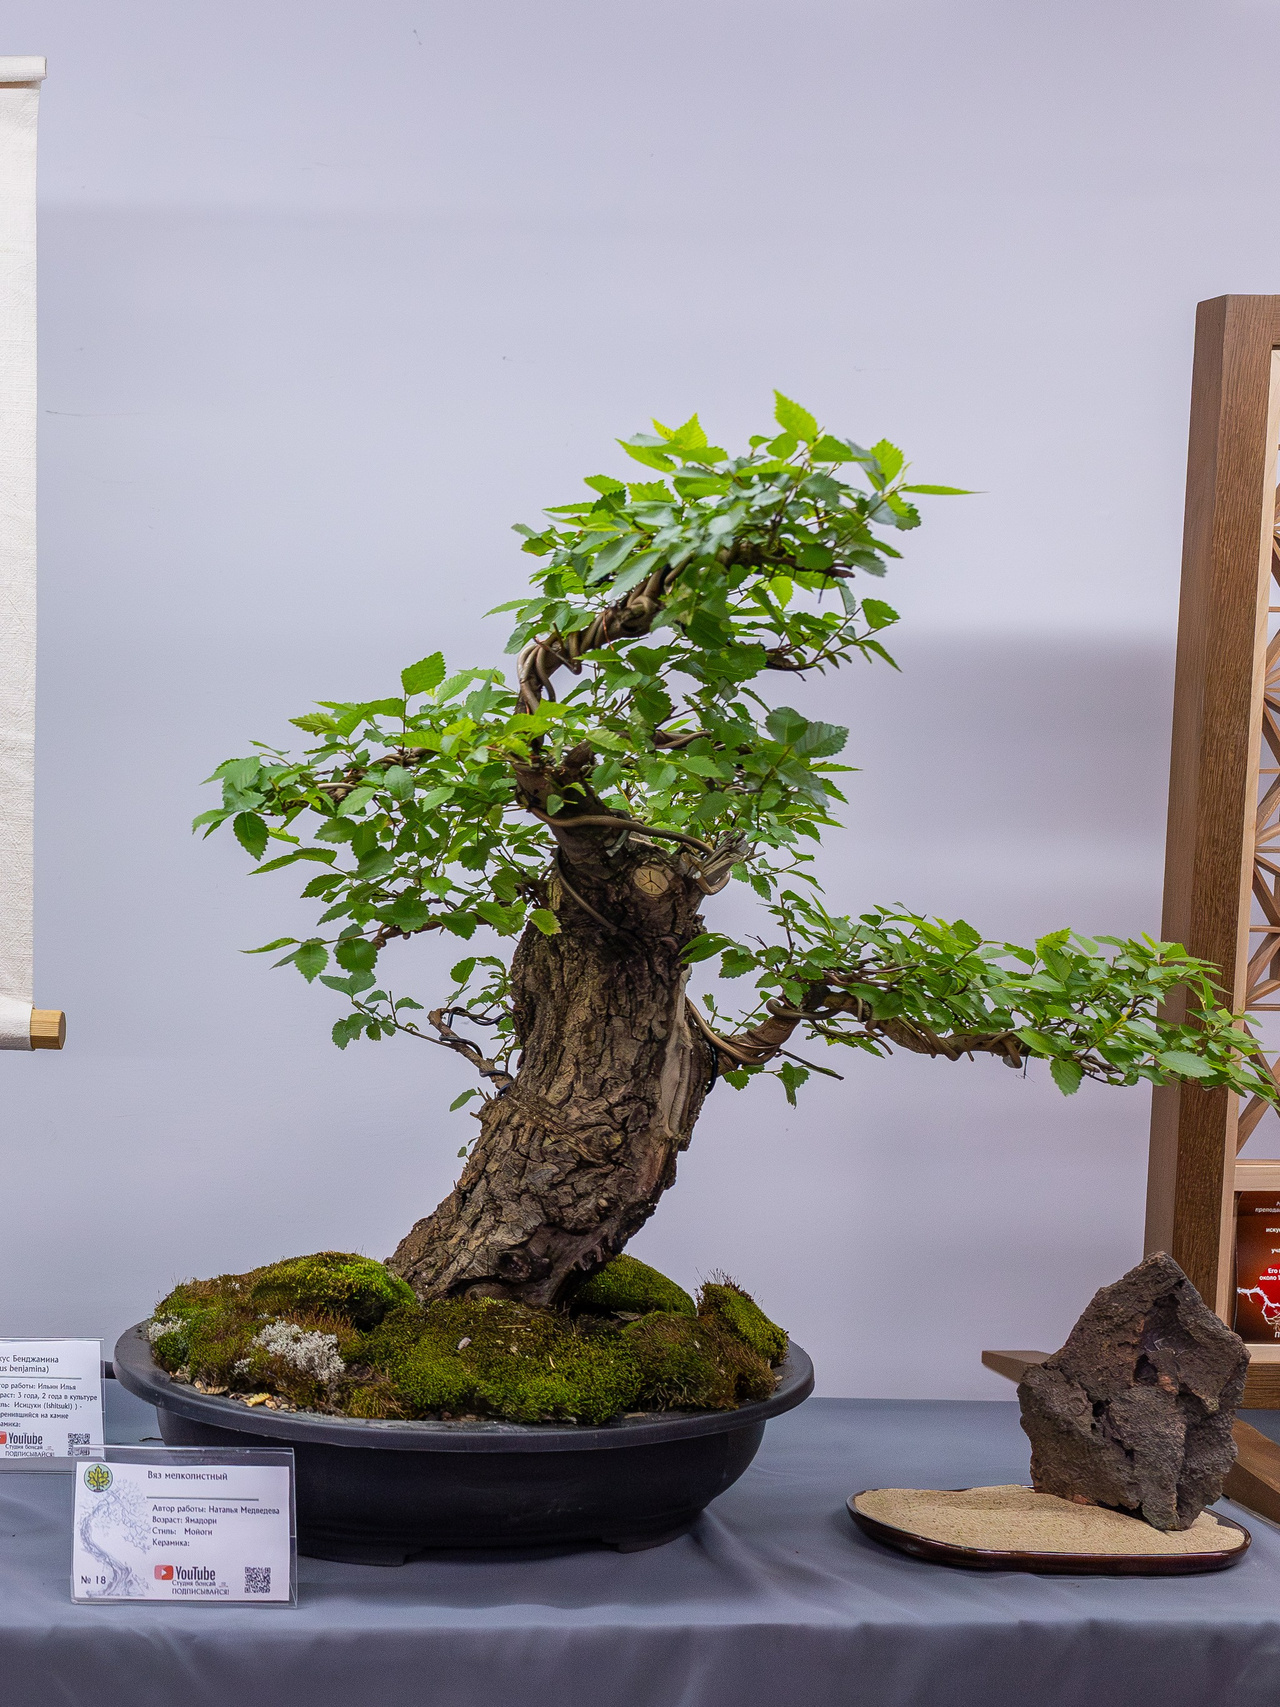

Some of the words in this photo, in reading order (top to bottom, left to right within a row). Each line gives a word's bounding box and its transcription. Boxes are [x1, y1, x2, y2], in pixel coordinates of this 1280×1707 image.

[12, 1354, 59, 1364] Бенджамина
[9, 1364, 50, 1374] benjamina)
[10, 1382, 36, 1390] работы:
[17, 1391, 22, 1399] 3
[69, 1394, 98, 1402] культуре
[14, 1401, 42, 1409] Исицуки
[8, 1432, 43, 1445] YouTube
[147, 1470, 162, 1479] Вяз
[164, 1471, 228, 1480] мелколистный
[152, 1504, 176, 1513] Автор
[177, 1504, 206, 1514] работы:
[208, 1505, 238, 1514] Наталья
[240, 1506, 280, 1515] Медведева
[152, 1515, 183, 1524] Возраст:
[184, 1516, 217, 1525] Ямадори
[152, 1526, 177, 1535] Стиль:
[184, 1527, 212, 1536] Мойоги
[152, 1538, 190, 1547] Керамика:
[175, 1566, 216, 1581] YouTube
[80, 1575, 92, 1584] №
[95, 1575, 107, 1585] 18
[171, 1579, 194, 1587] Студия
[194, 1579, 216, 1587] бонсай
[171, 1587, 230, 1596] ПОДПИСЫВАЙСЯ!
